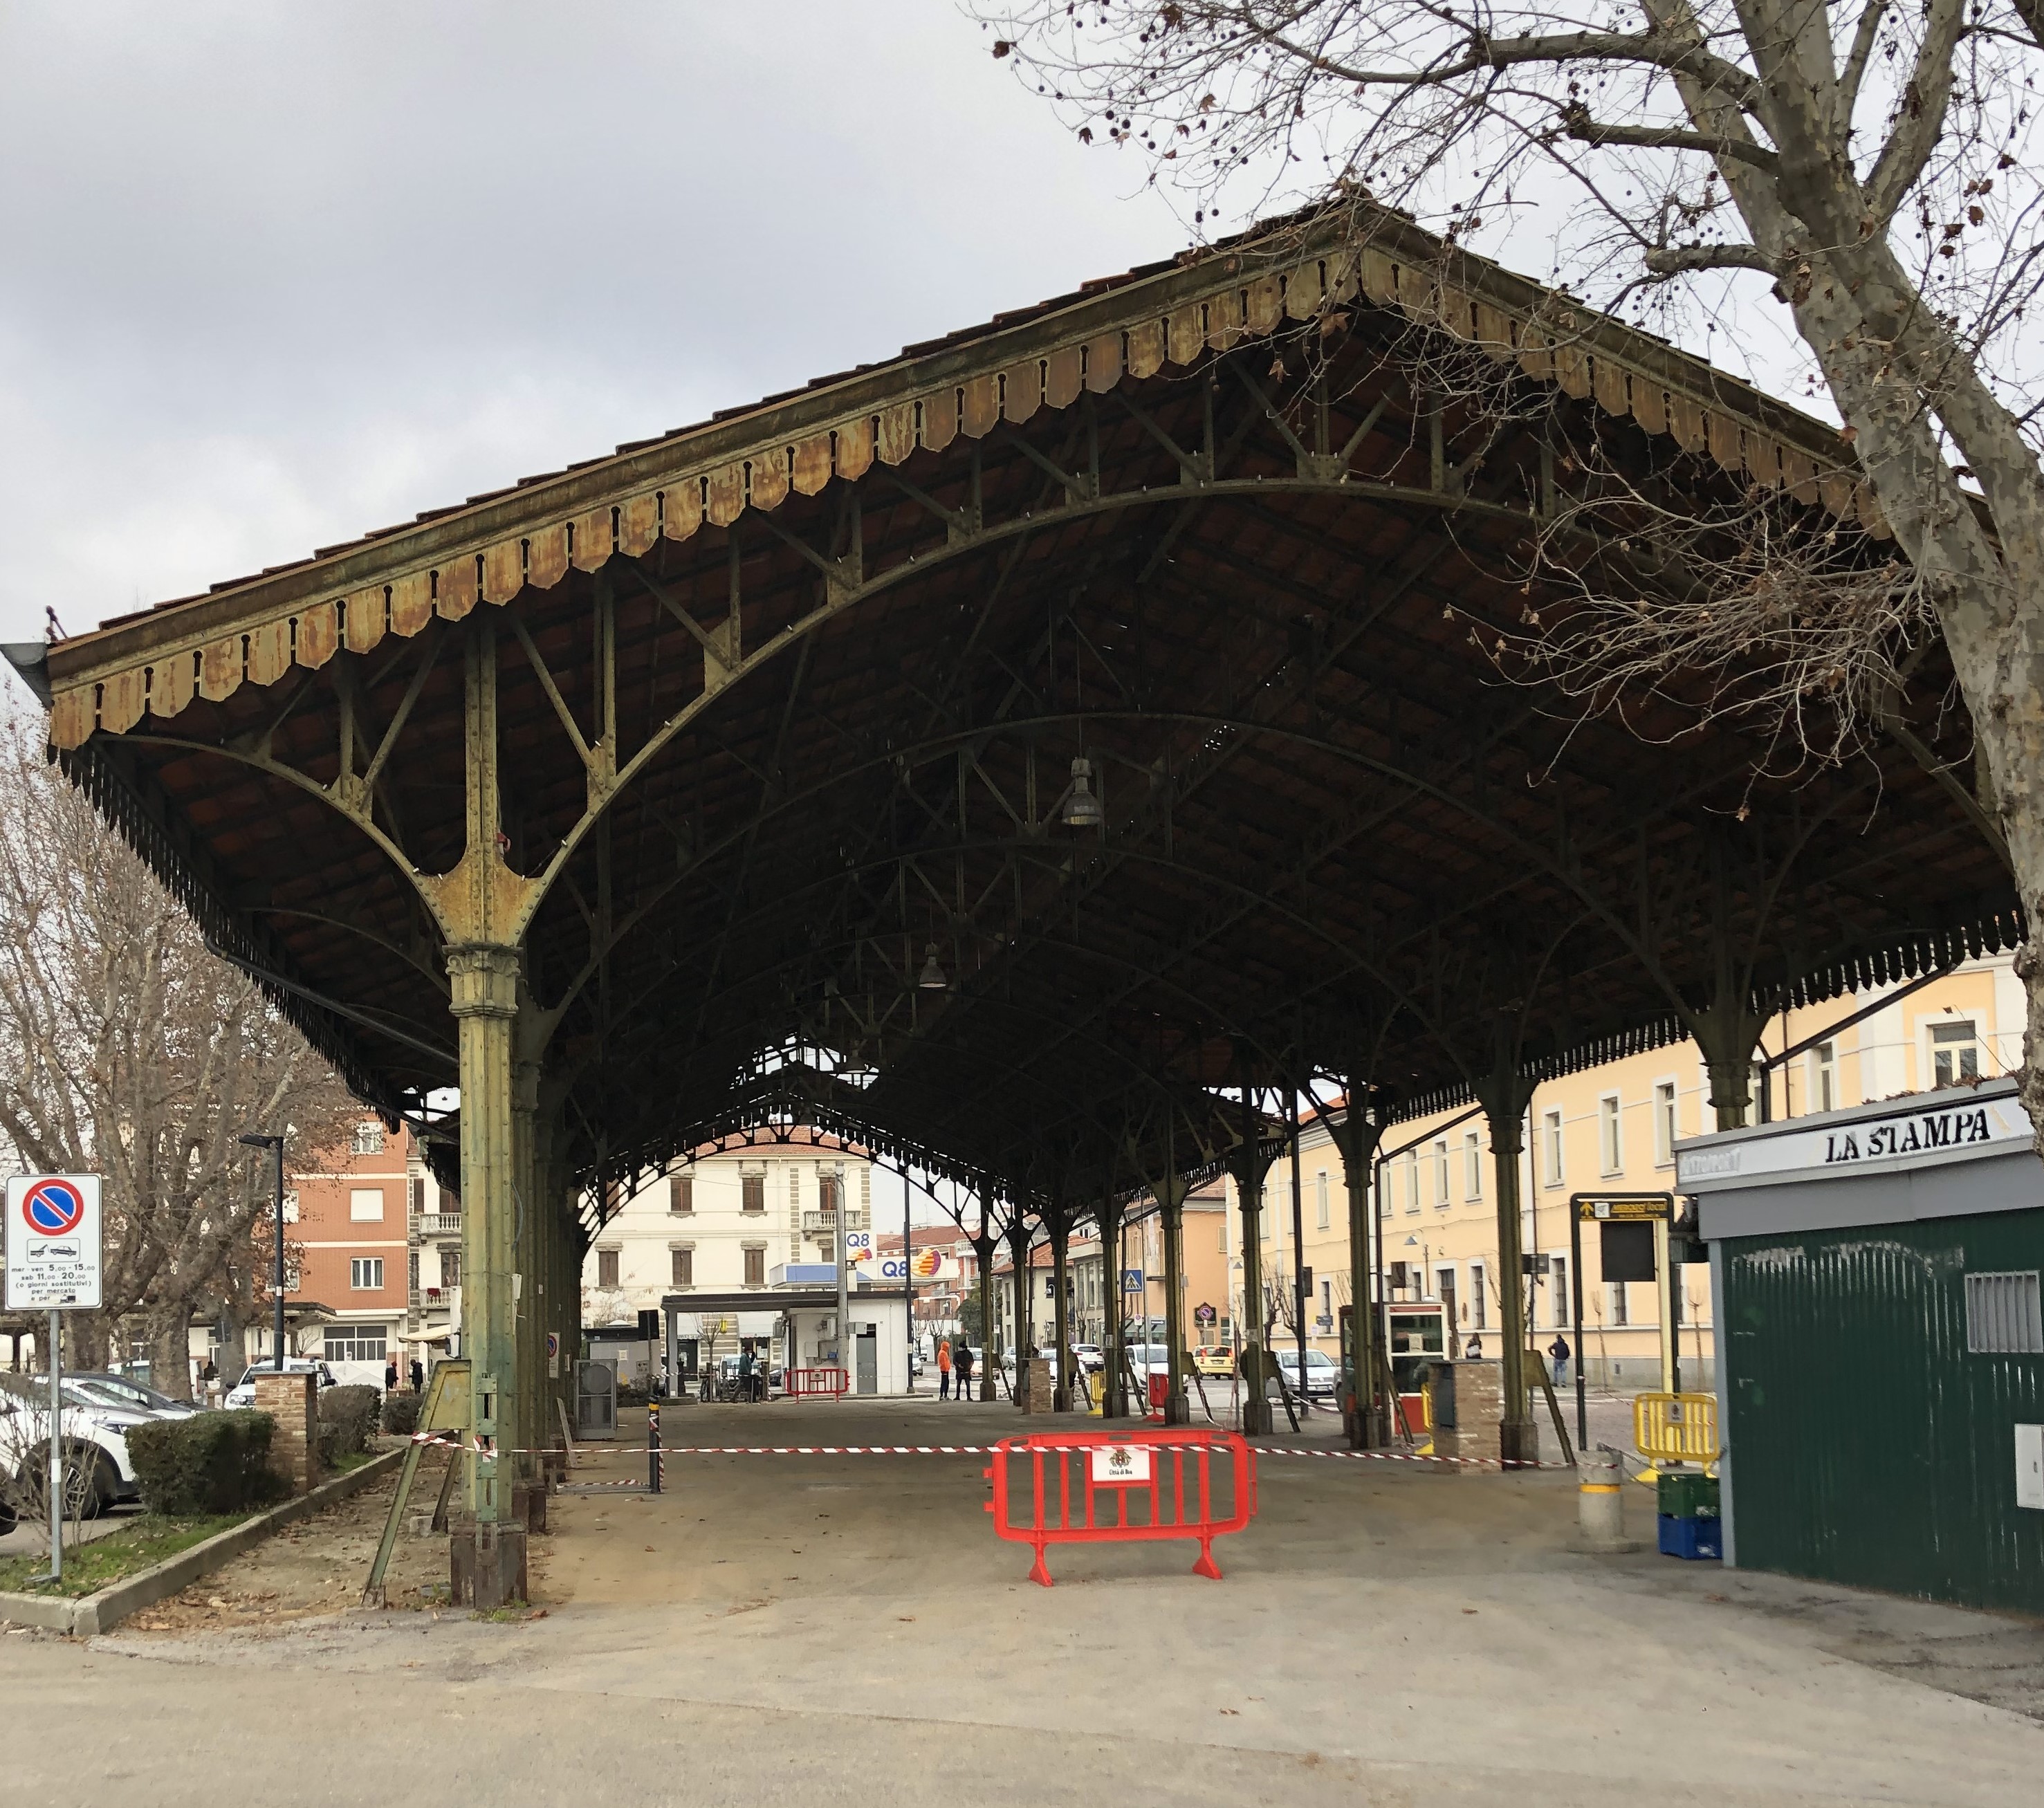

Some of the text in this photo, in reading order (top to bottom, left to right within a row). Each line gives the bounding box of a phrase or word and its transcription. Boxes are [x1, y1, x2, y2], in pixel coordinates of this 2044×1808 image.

[1825, 1109, 1991, 1163] LA STAMPA
[847, 1233, 869, 1247] Q8
[883, 1261, 907, 1277] Q8
